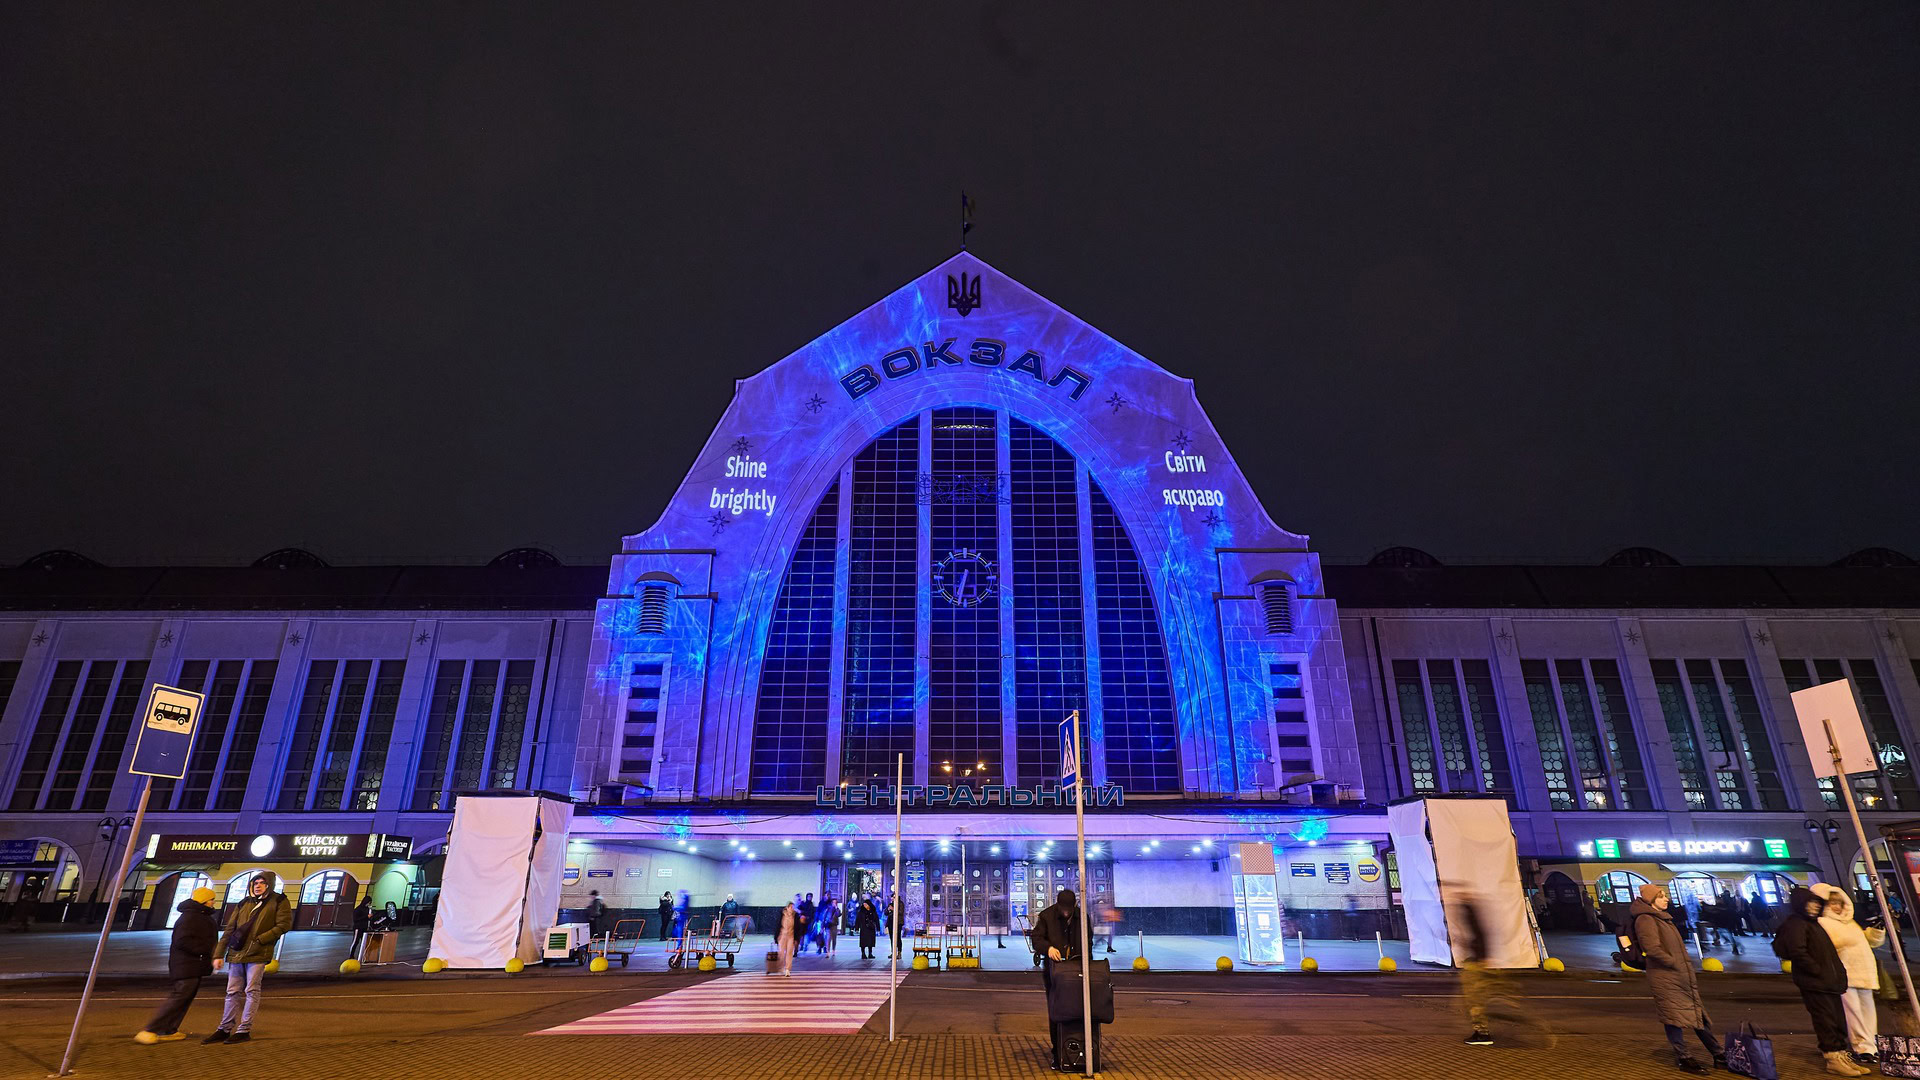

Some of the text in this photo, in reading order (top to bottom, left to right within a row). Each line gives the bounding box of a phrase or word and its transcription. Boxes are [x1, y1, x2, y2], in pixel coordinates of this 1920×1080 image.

[838, 336, 1094, 402] ВОКЗАЛ
[725, 455, 767, 479] Shine
[1165, 449, 1206, 474] Світи
[710, 487, 777, 516] brightly
[1163, 485, 1224, 512] яскраво
[816, 783, 1125, 809] ЦЕНТРАЛЬНИЙ
[171, 841, 237, 851] МІНІМАРКЕТ
[293, 835, 348, 847] КИЇВСЬКІ
[300, 846, 338, 857] ТОРТИ
[1631, 840, 1667, 853] ВСЕ
[1668, 841, 1681, 853] В
[1685, 840, 1750, 855] ДОРОГУ
